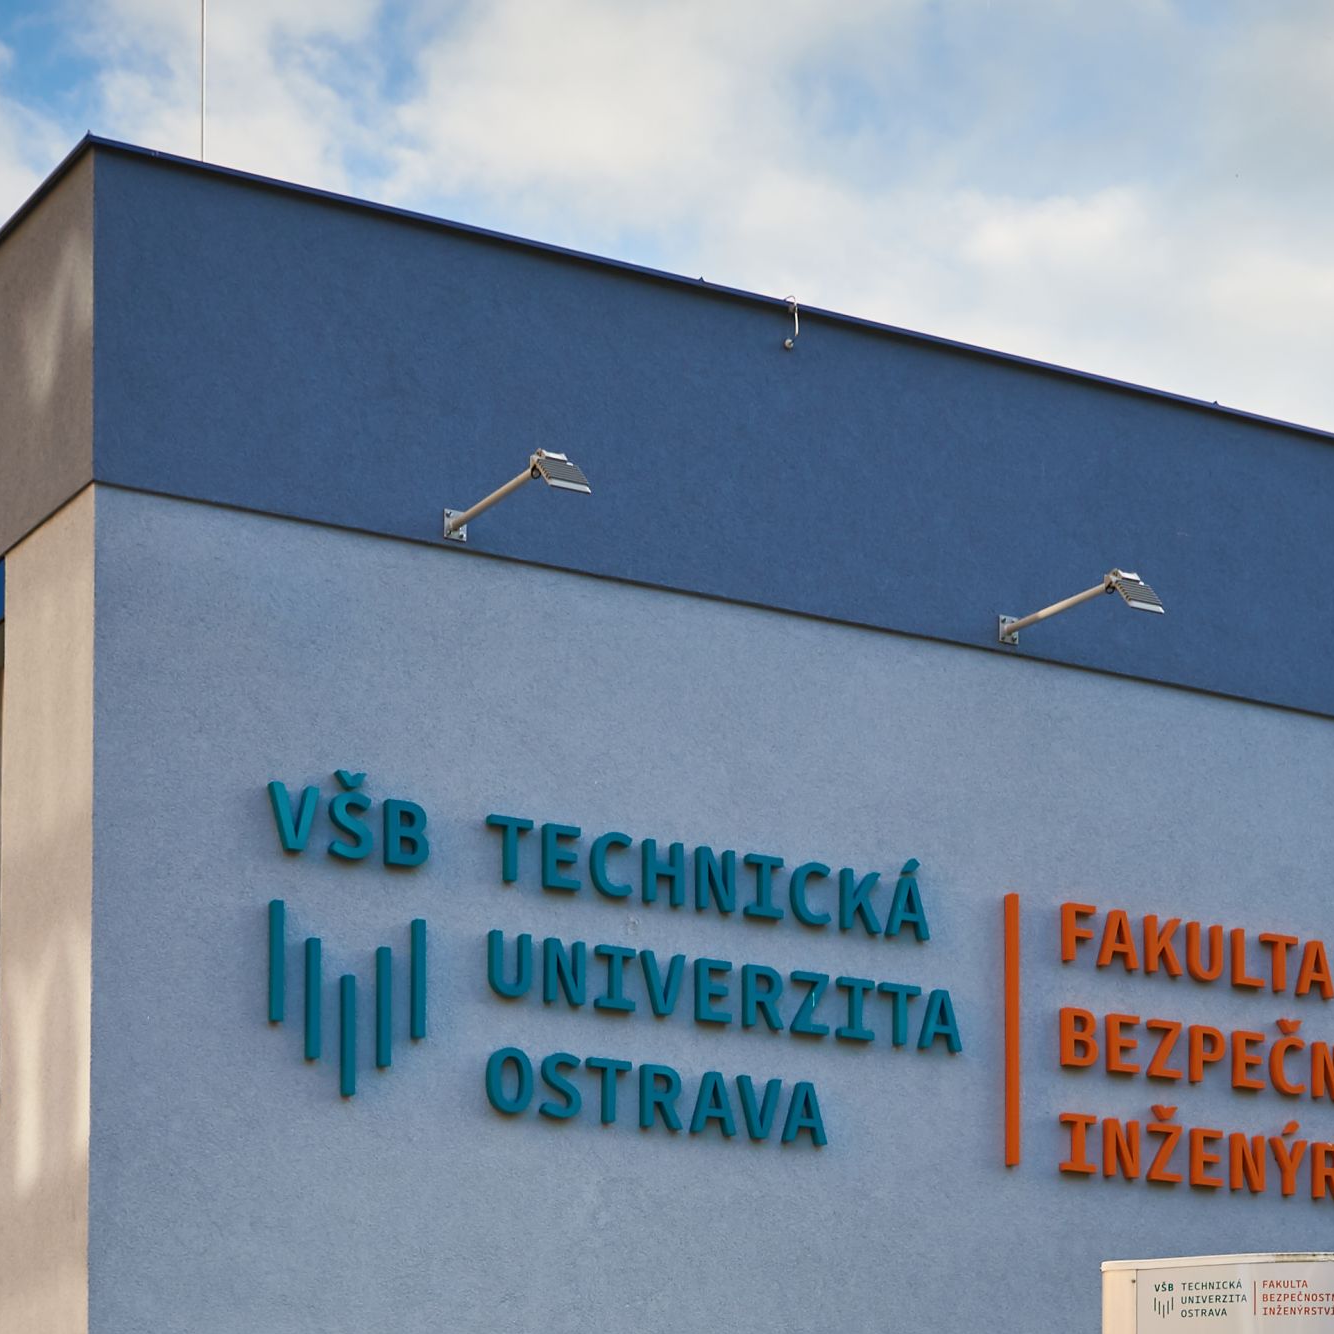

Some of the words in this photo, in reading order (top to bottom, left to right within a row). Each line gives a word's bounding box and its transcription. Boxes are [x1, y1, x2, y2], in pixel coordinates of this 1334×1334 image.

[267, 769, 430, 867] VŠB
[486, 813, 930, 941] TECHNICKÁ
[1060, 902, 1334, 1000] FAKULTA
[487, 929, 963, 1054] UNIVERZITA
[485, 1047, 828, 1146] OSTRAVA
[1154, 1283, 1174, 1292] VŠB
[1181, 1279, 1242, 1292] TECHNICKÁ
[1181, 1294, 1247, 1304] UNIVERZITA
[1262, 1280, 1308, 1289] FAKULTA
[1180, 1308, 1228, 1318] OSTRAVA
